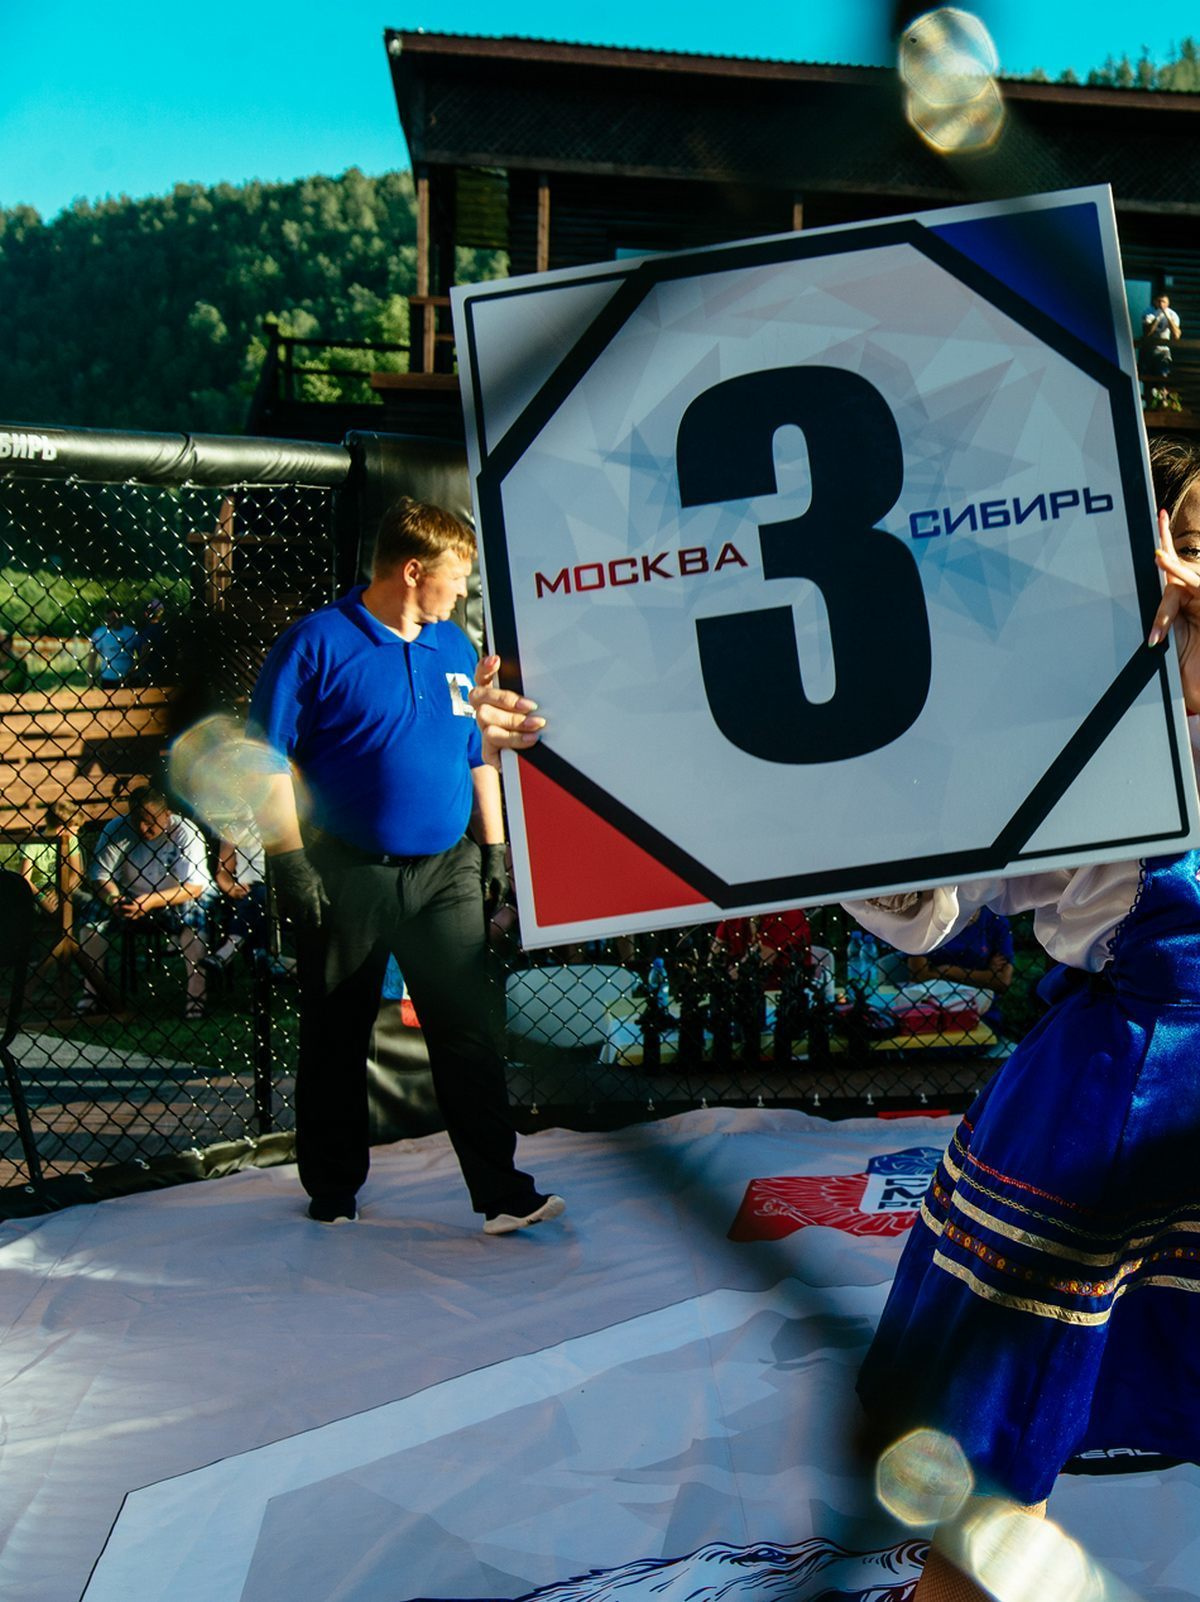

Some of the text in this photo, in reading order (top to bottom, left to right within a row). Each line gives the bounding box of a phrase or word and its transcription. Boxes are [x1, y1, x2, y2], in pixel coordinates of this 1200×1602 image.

[534, 487, 1114, 598] МОСКВА СИБИРЬ
[676, 365, 932, 765] 3
